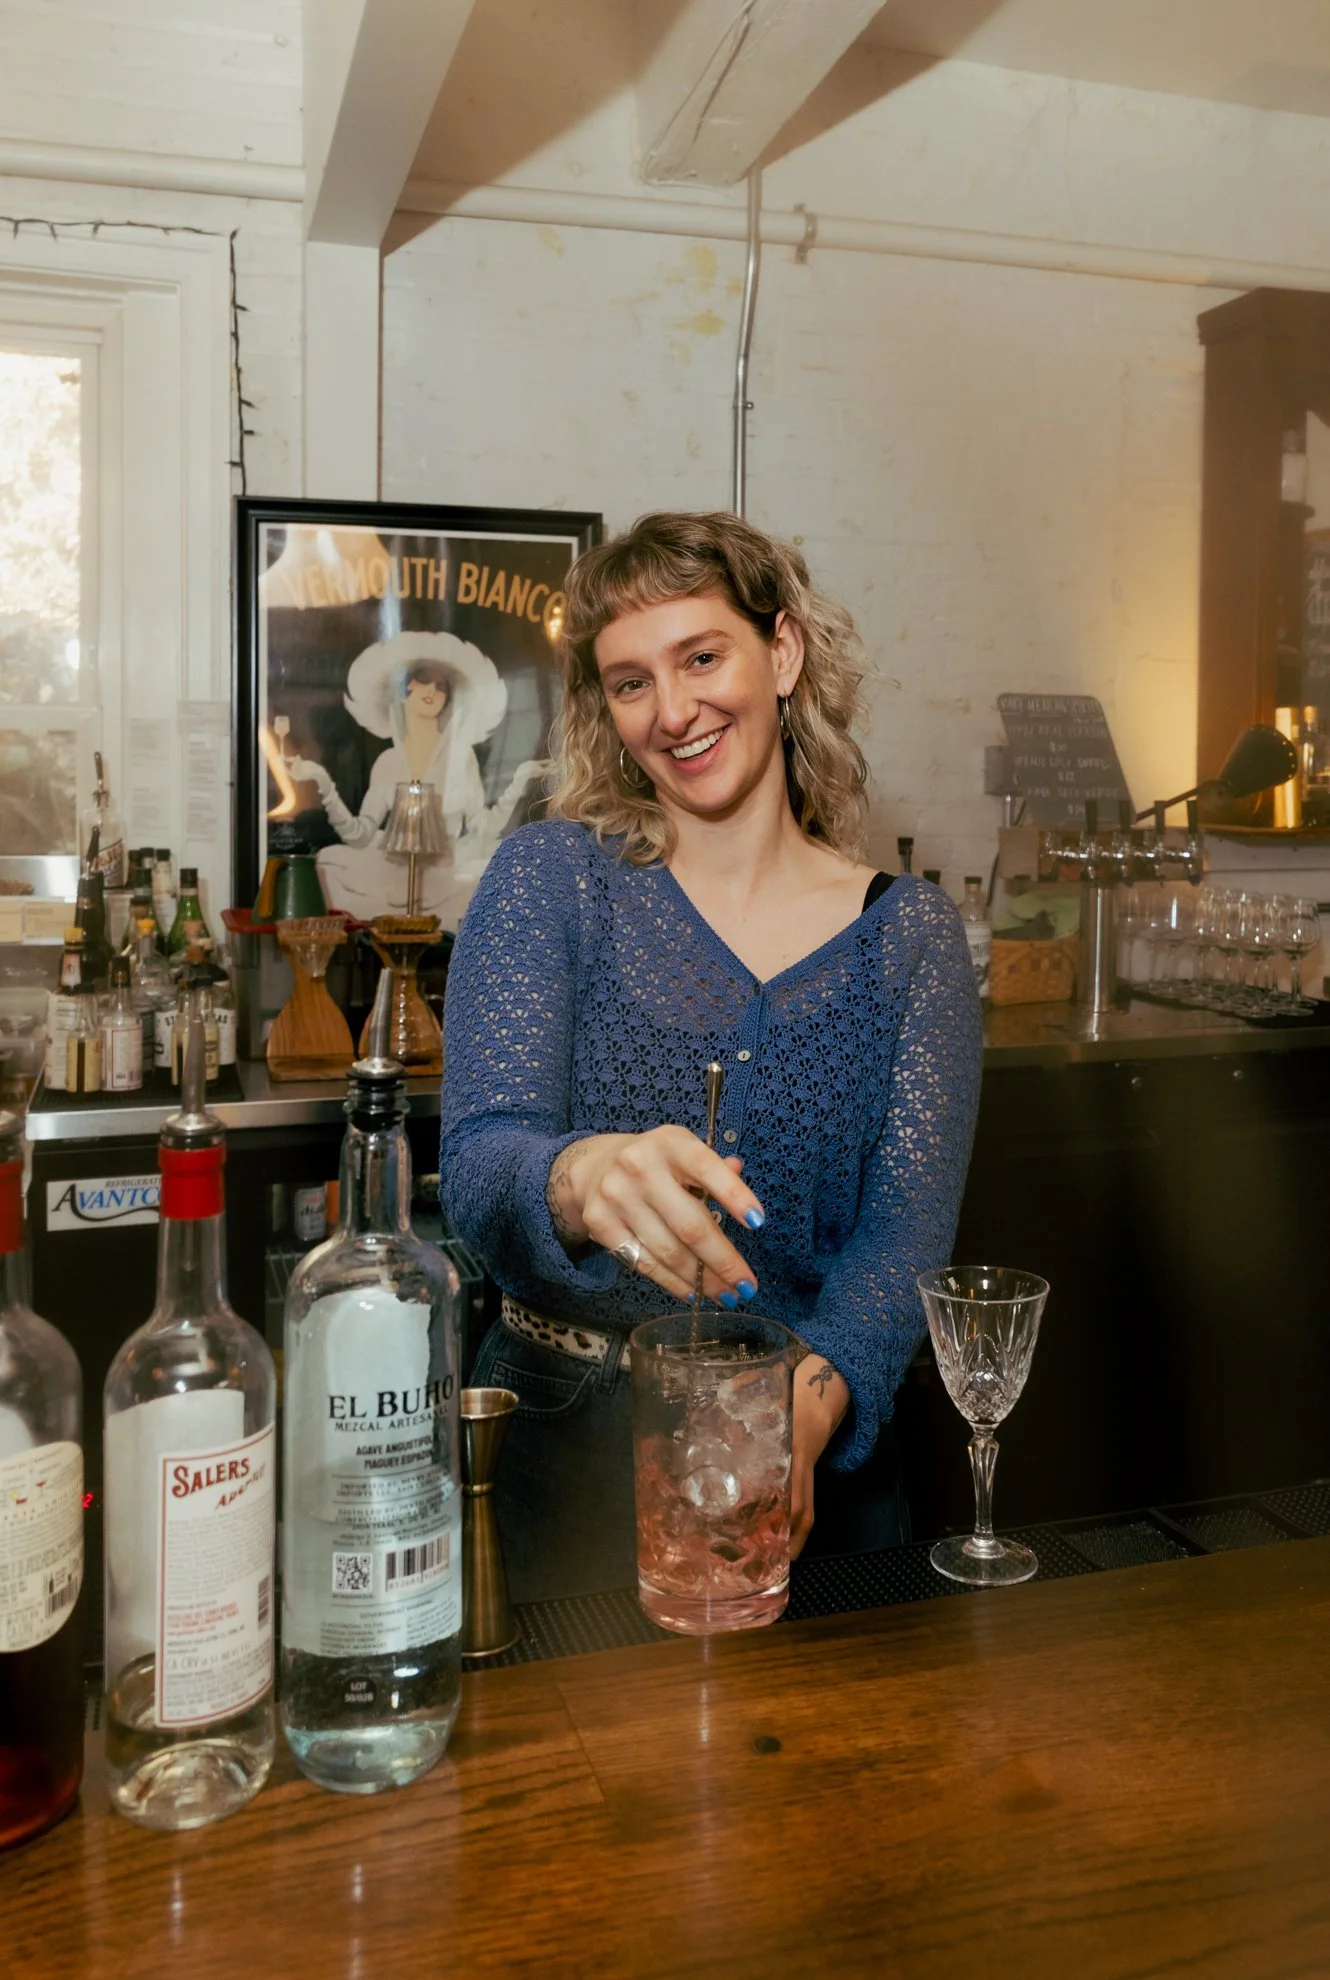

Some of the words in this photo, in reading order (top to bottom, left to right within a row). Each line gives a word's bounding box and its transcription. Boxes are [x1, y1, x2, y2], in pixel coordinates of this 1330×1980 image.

[281, 556, 447, 611] VERMOUTH
[458, 562, 566, 626] BIANCO
[51, 1183, 160, 1219] AVANTC
[329, 1395, 367, 1420] EL
[377, 1375, 454, 1418] BUHO
[334, 1421, 382, 1432] MEZCAL
[356, 1444, 382, 1456] AGAVE
[364, 1456, 399, 1470] MAGUEY
[350, 1681, 367, 1691] LOT
